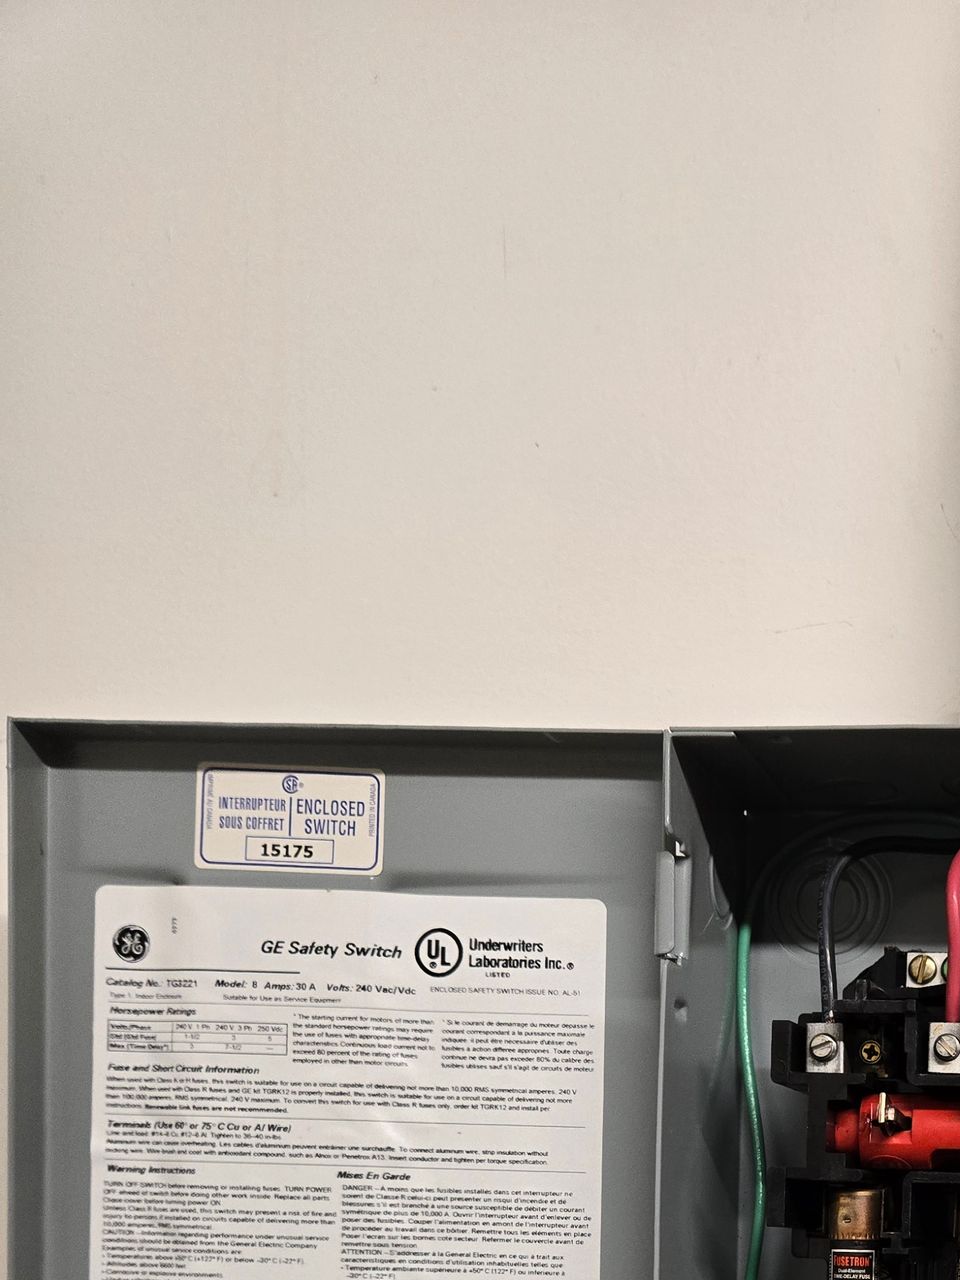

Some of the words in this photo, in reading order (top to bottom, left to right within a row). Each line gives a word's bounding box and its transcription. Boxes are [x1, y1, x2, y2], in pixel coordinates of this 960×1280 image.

[219, 797, 286, 812] INTERRUPTEUR
[297, 799, 364, 817] ENCLOSED
[219, 816, 242, 829] SOUS
[246, 818, 284, 830] COFFRET
[305, 819, 356, 836] SWITCH
[261, 844, 313, 858] 15175
[261, 940, 285, 954] GE
[288, 942, 338, 959] Safety
[344, 943, 402, 959] Switch
[469, 938, 543, 952] Underwriters
[469, 955, 540, 969] Laboratories
[106, 978, 143, 988] Catalog
[215, 980, 246, 988] Model:
[264, 982, 293, 990] Amps:
[355, 985, 372, 993] 240
[375, 985, 416, 996] Vac/Vdc
[167, 1007, 196, 1016] Ratings
[176, 1065, 202, 1073] Circuit
[205, 1066, 260, 1074] Information
[108, 1120, 151, 1129] Terminals
[268, 1124, 292, 1133] Wire)
[107, 1164, 146, 1175] Warning
[148, 1166, 196, 1175] Instructions
[337, 1171, 364, 1181] Mises
[366, 1172, 379, 1181] En
[382, 1173, 411, 1182] Garde
[834, 1255, 869, 1266] FUSETRON
